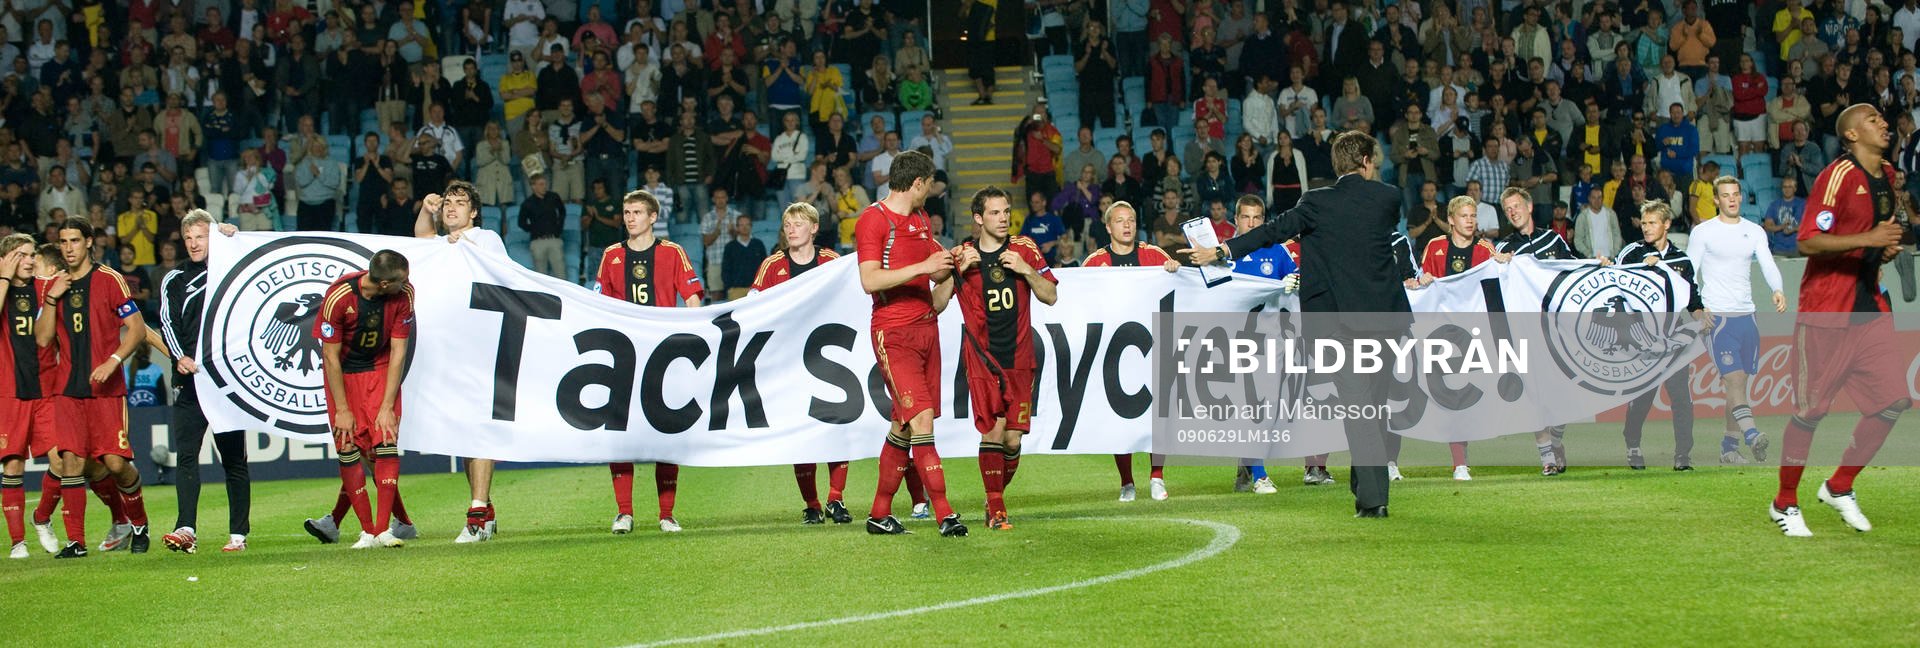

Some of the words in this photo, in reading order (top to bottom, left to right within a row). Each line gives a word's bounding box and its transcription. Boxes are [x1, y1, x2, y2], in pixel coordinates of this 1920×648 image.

[632, 283, 649, 304] 16
[1570, 271, 1660, 305] DEUTSCHER
[987, 287, 1014, 312] 20
[15, 316, 33, 336] 21
[72, 312, 83, 333] 8
[359, 331, 378, 348] 13
[469, 281, 774, 434] Tack
[1017, 402, 1031, 424] 2
[118, 430, 128, 449] 8
